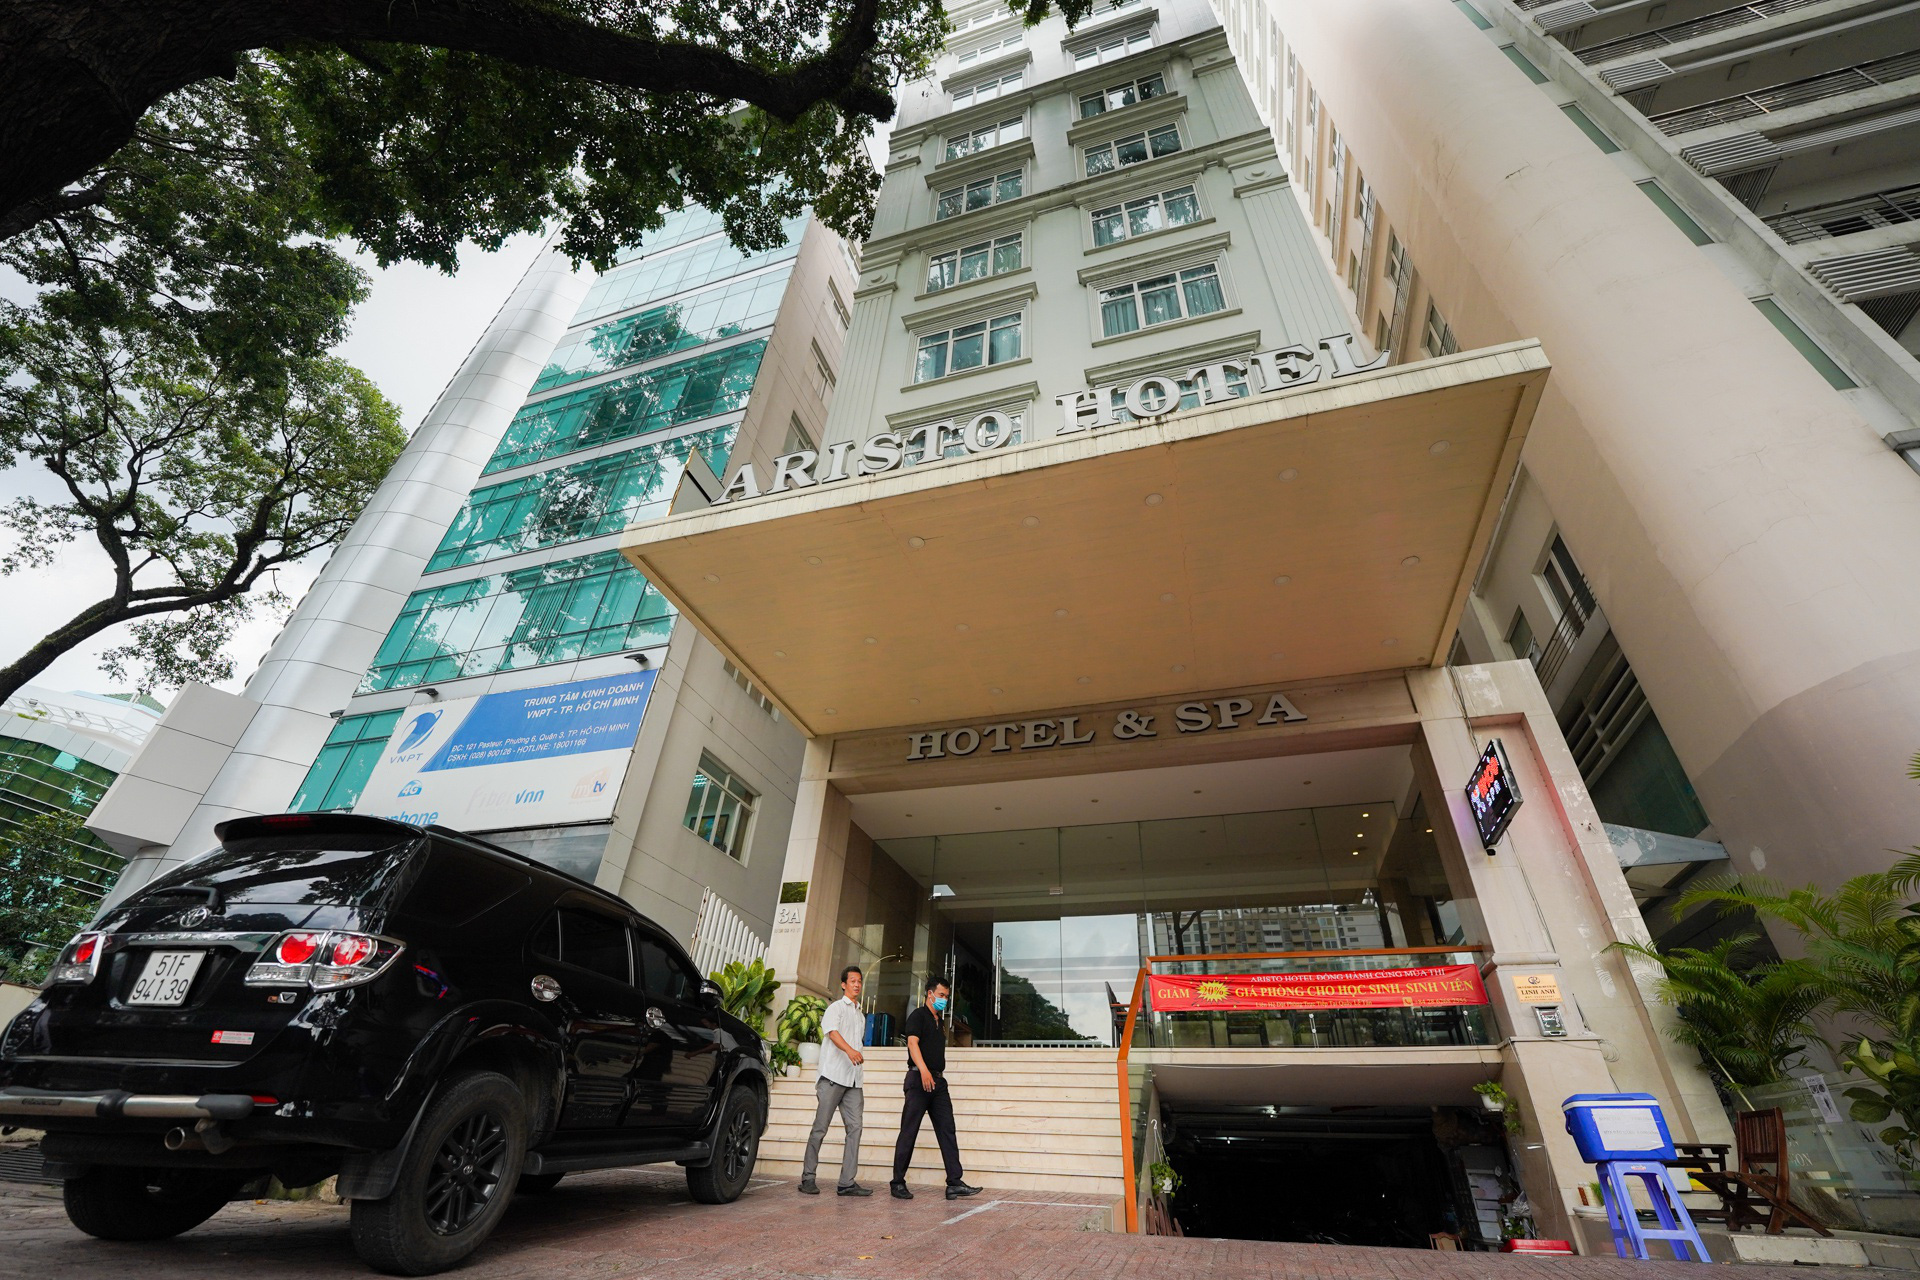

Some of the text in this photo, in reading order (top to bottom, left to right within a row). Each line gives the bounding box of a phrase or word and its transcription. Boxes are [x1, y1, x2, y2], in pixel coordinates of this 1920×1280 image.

[711, 333, 1391, 506] ARISTO HOTEL
[524, 682, 644, 708] TRUNG TÂM KINH DOANH
[526, 708, 553, 720] VNPT
[560, 705, 573, 715] TP.
[592, 696, 613, 710] CHÍ
[612, 695, 640, 708] MINH
[466, 743, 477, 751] 121
[568, 729, 578, 737] TP.
[593, 723, 609, 734] CHÍ
[608, 722, 630, 732] MINH
[906, 693, 1308, 761] HOTEL & SPA
[389, 753, 424, 764] VNPT
[517, 743, 551, 754] HOTLINE:
[401, 783, 422, 796] 4G
[778, 907, 801, 924] 3A
[155, 954, 191, 976] 51F
[1250, 975, 1283, 983] ARISTO
[1284, 974, 1313, 982] HOTEL
[1428, 968, 1446, 976] THI
[132, 978, 189, 1001] 941.39
[1158, 978, 1474, 999] GIẢM 20% GIÁ PHÒNG CHO HỌC SINH, SINH VIÊN
